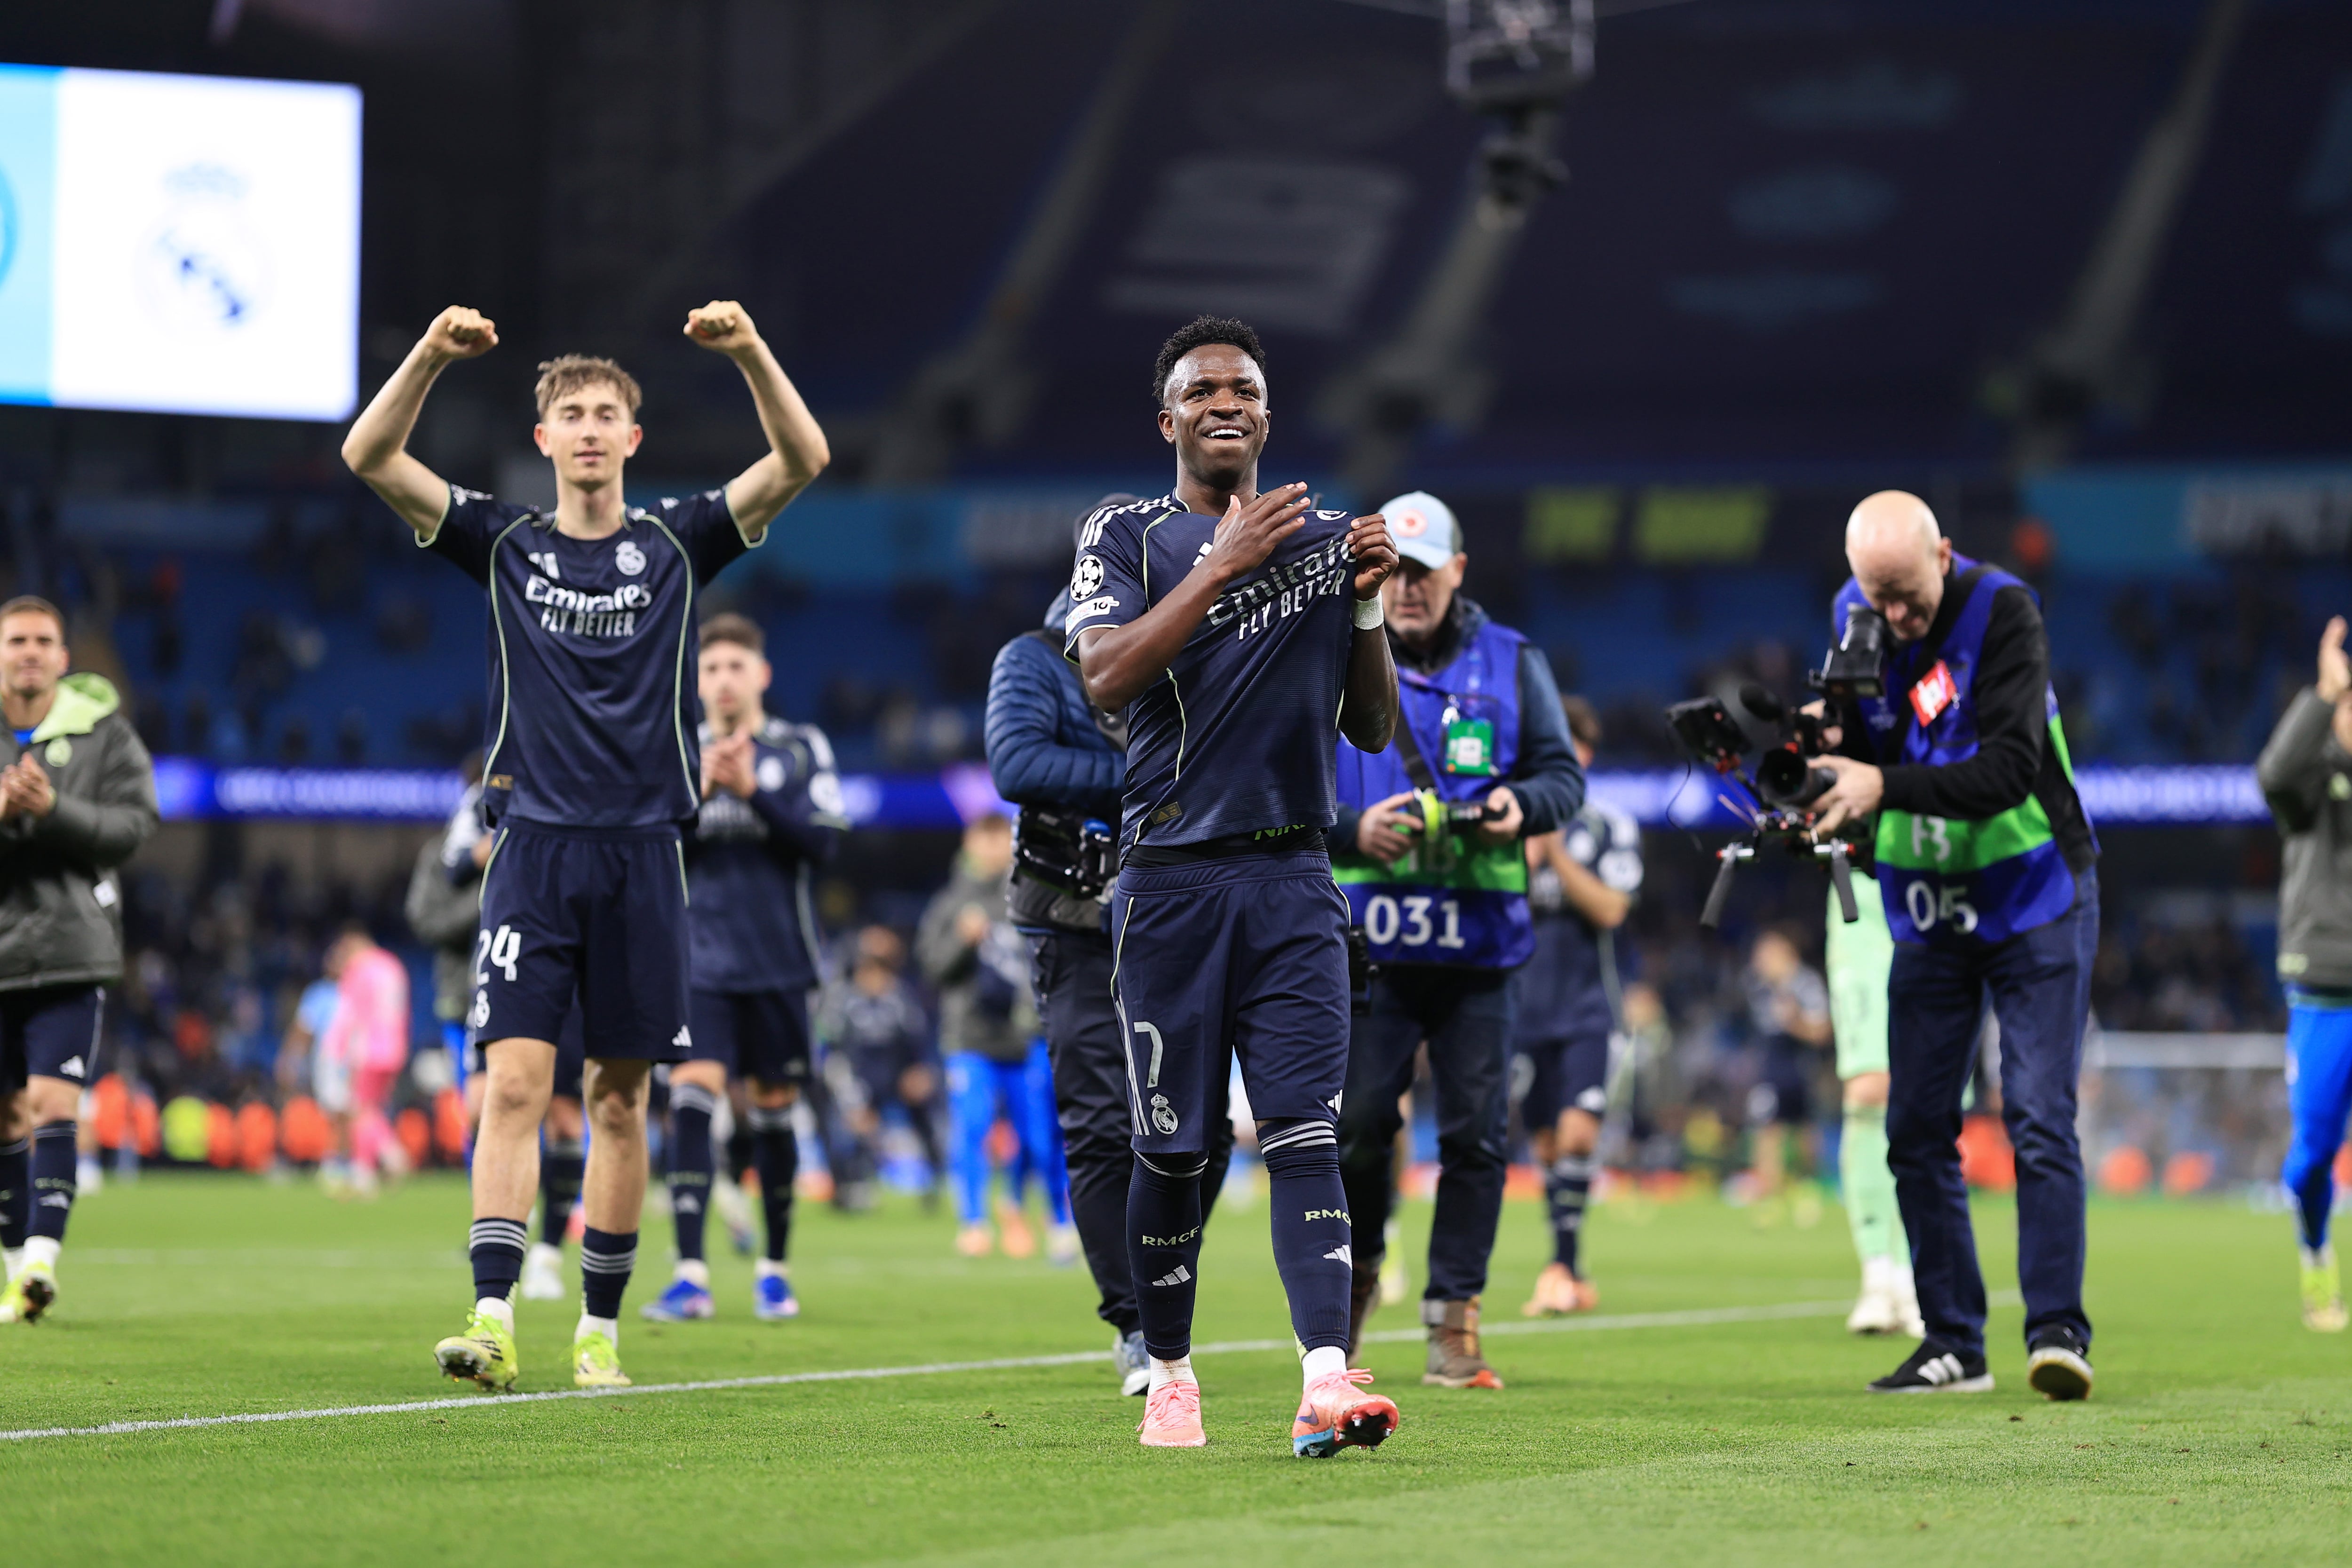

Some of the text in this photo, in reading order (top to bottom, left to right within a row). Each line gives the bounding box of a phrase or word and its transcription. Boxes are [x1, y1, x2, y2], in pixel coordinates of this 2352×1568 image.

[525, 573, 652, 612] Emirates
[1093, 601, 1108, 610] 10
[1239, 568, 1347, 640] FLY BETTER
[541, 607, 635, 637] FLY BETTER
[1365, 894, 1466, 950] 031
[476, 924, 522, 986] 24
[1133, 1021, 1163, 1089] 7
[1142, 1225, 1200, 1246] RMCF
